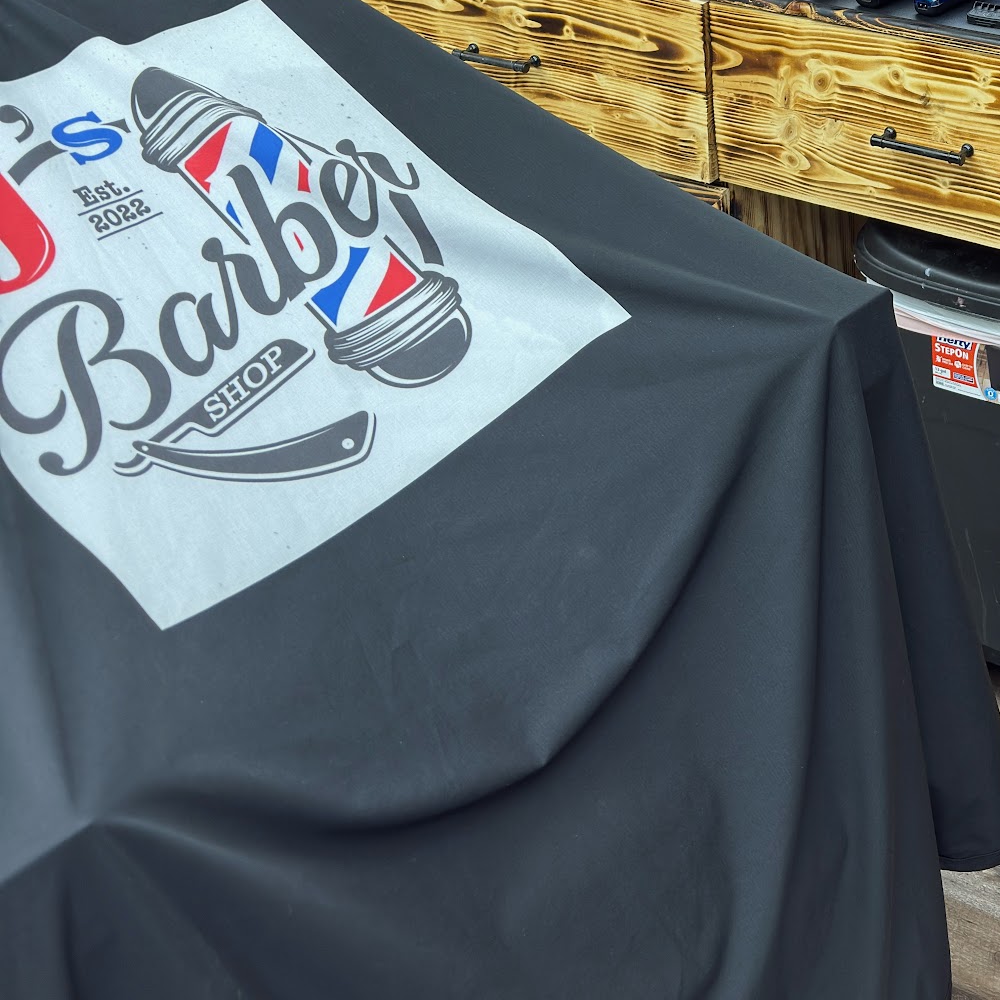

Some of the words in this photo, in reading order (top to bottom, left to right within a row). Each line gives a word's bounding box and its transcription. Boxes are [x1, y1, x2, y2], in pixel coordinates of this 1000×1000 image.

[72, 179, 131, 208] Est.
[88, 197, 152, 234] 2022
[0, 137, 421, 477] Barber
[202, 345, 284, 424] SHOP
